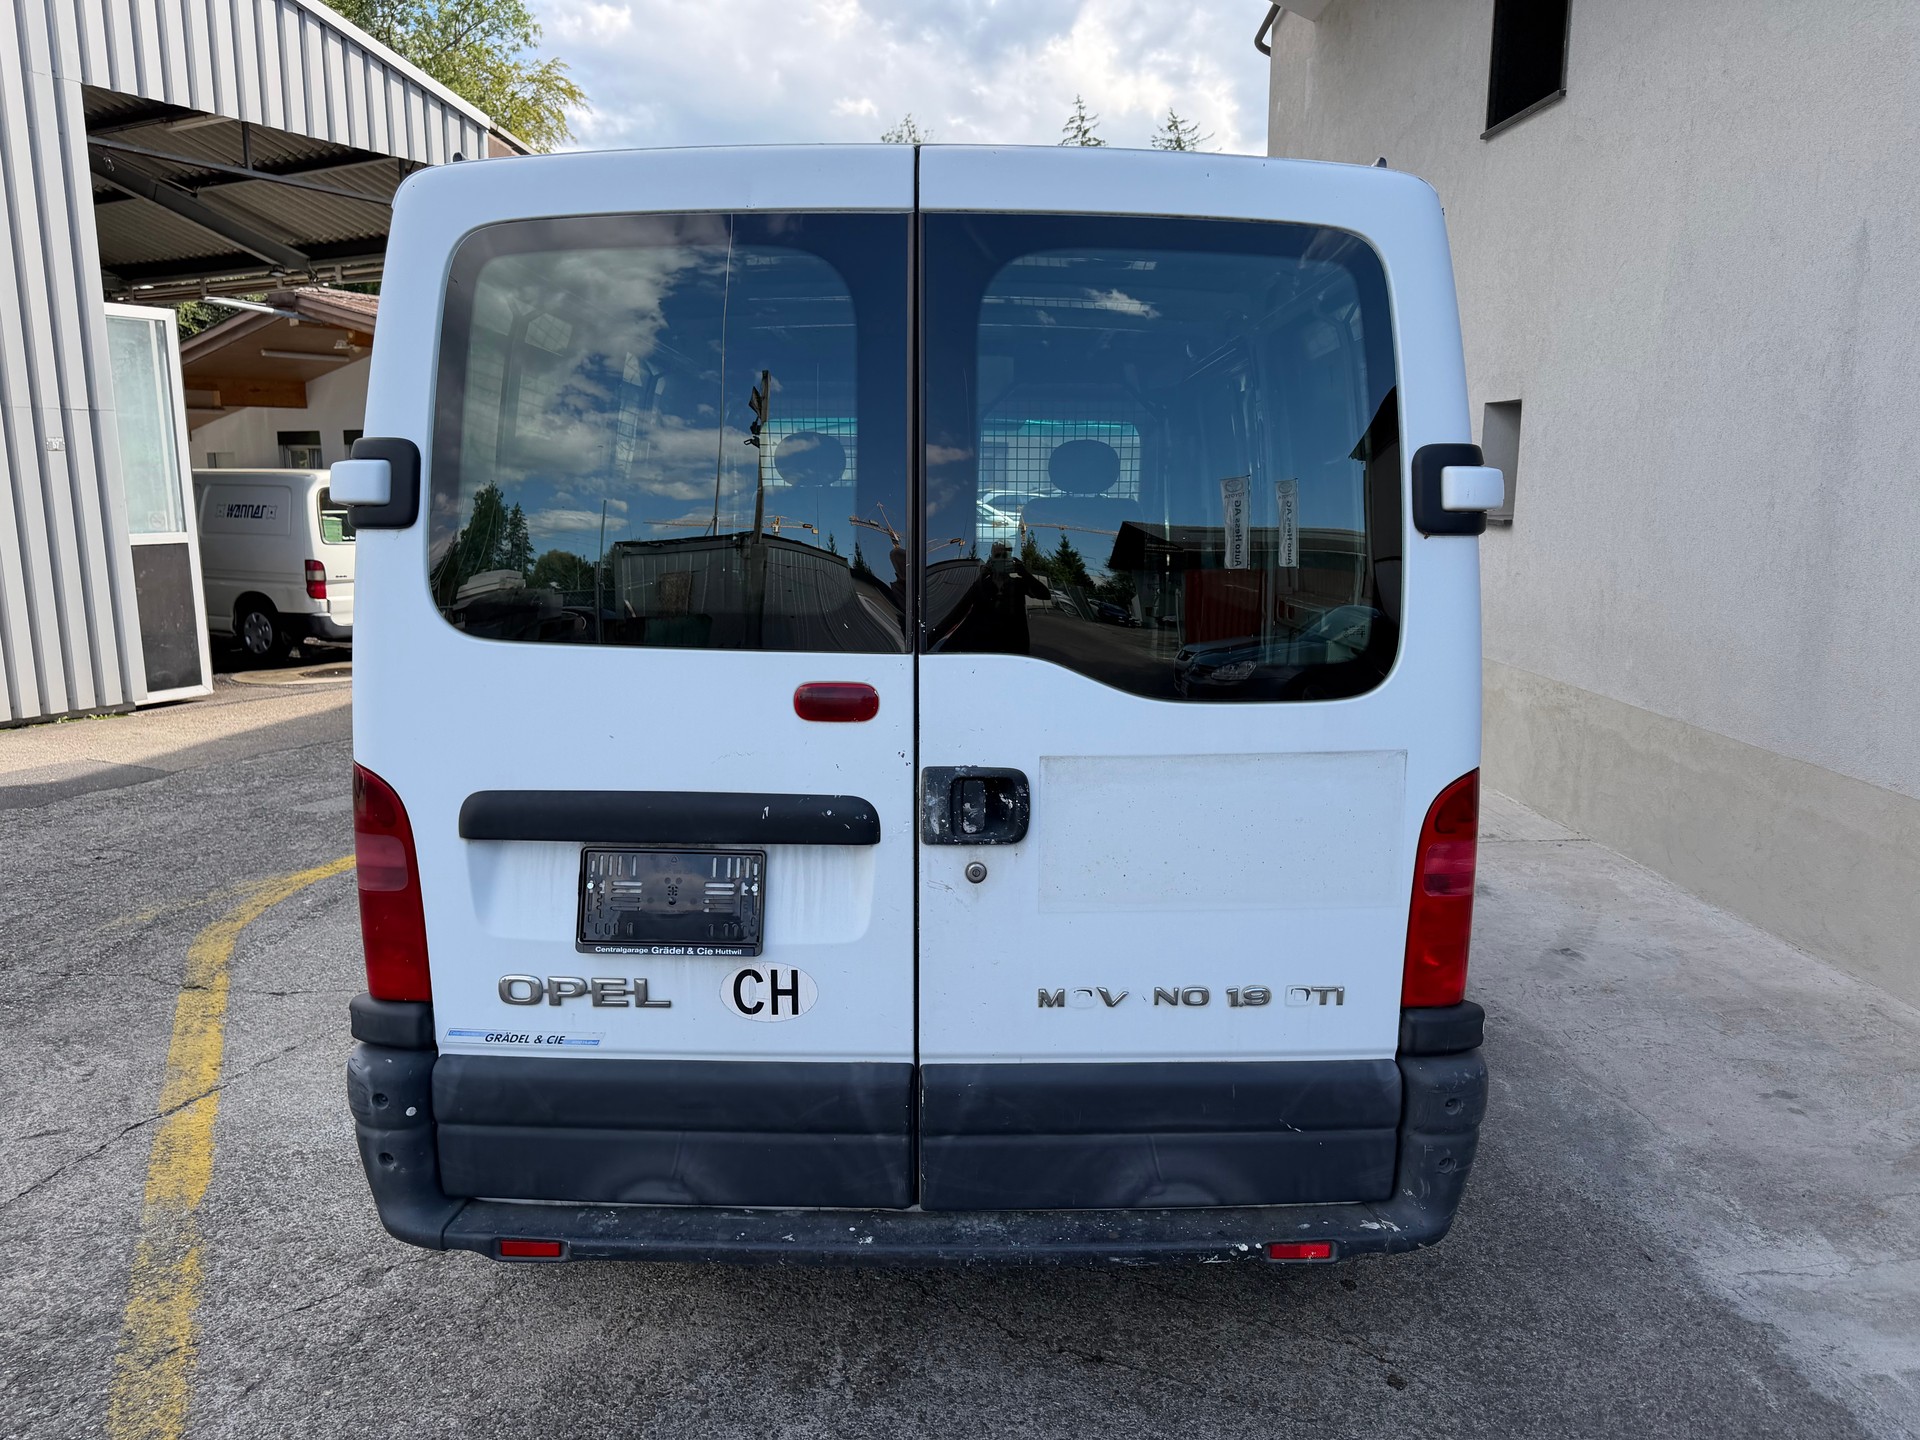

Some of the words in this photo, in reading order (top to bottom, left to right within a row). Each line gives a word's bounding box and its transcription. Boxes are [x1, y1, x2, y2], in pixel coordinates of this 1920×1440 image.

[595, 946, 649, 955] Centralgarage
[651, 946, 684, 955] Grädel
[686, 946, 695, 956] &
[696, 947, 713, 956] Cie
[715, 948, 742, 956] Huttwil
[497, 974, 672, 1008] OPEL
[732, 968, 800, 1016] CH
[484, 1032, 530, 1044] GRÄDEL
[533, 1034, 543, 1045] &
[546, 1034, 566, 1045] CIE
